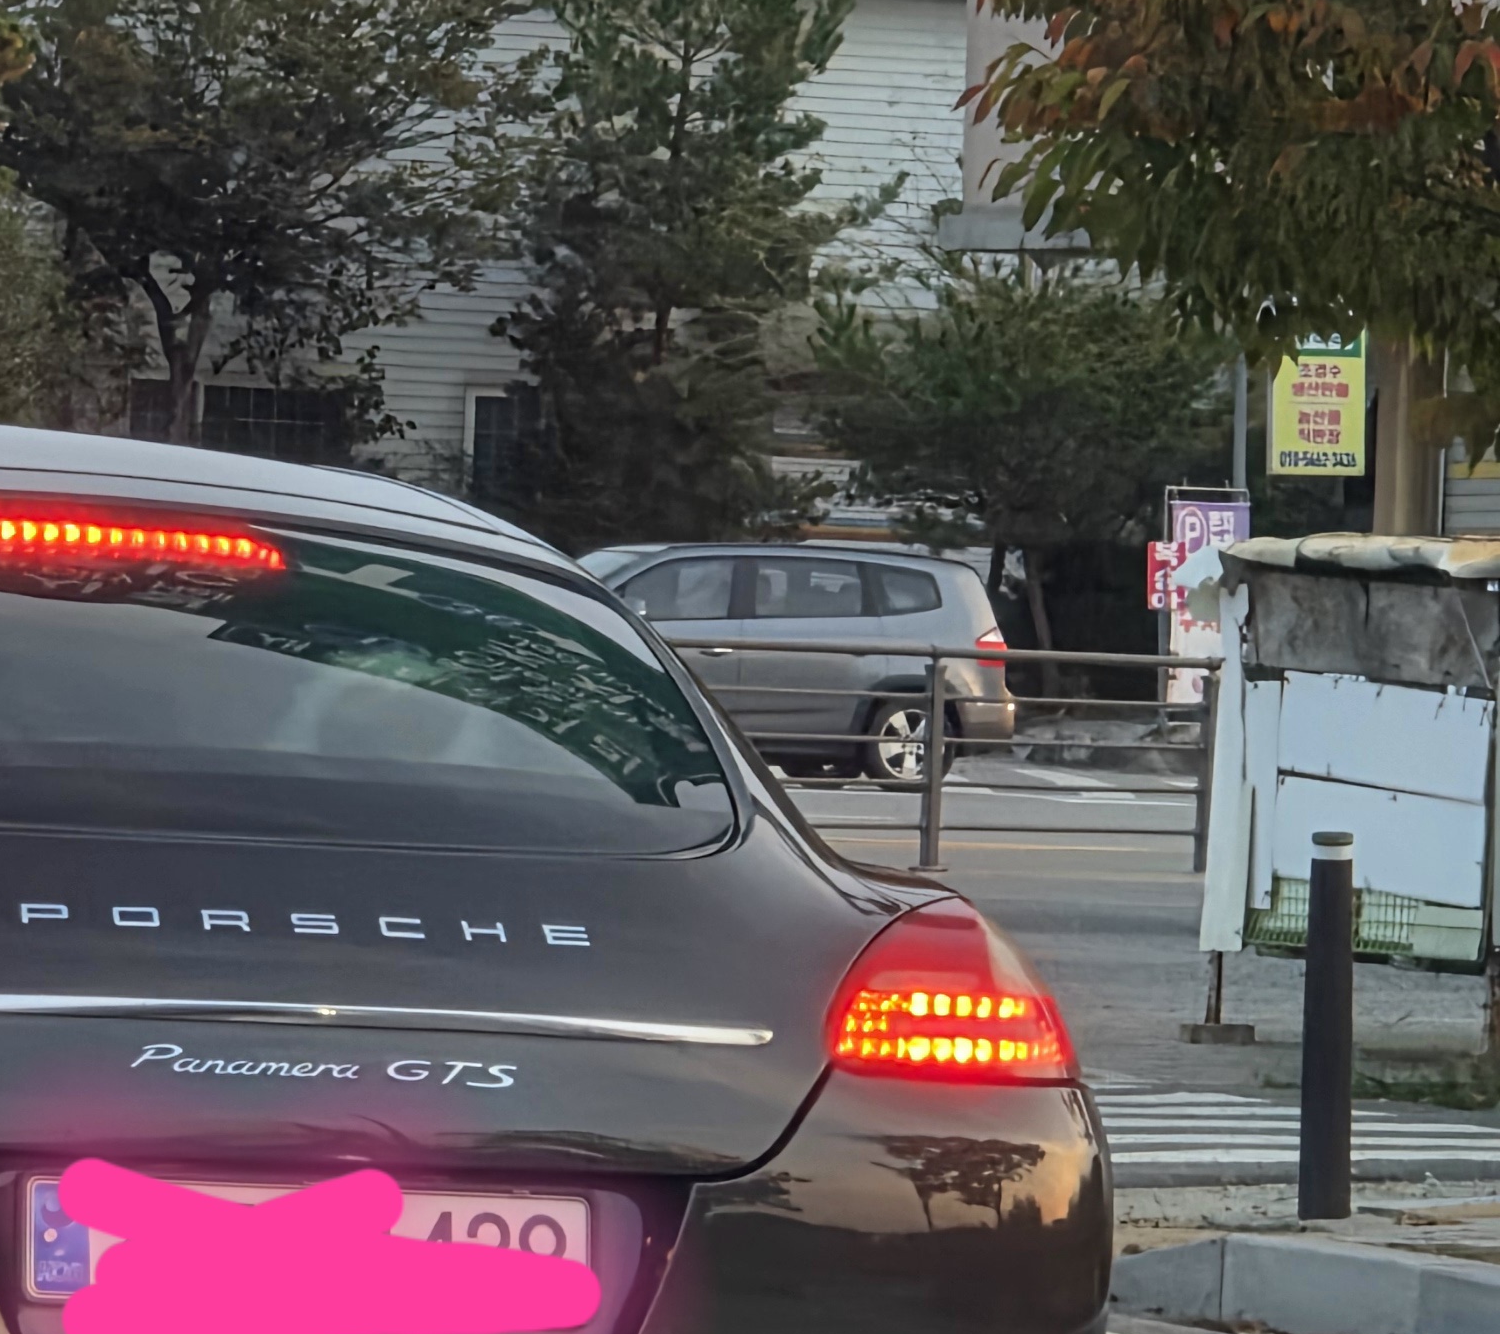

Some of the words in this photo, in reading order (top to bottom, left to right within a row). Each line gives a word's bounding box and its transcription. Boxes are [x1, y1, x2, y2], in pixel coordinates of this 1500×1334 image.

[19, 901, 592, 948] PORSCHE
[130, 1043, 360, 1080] Panamera
[386, 1059, 518, 1089] GTS
